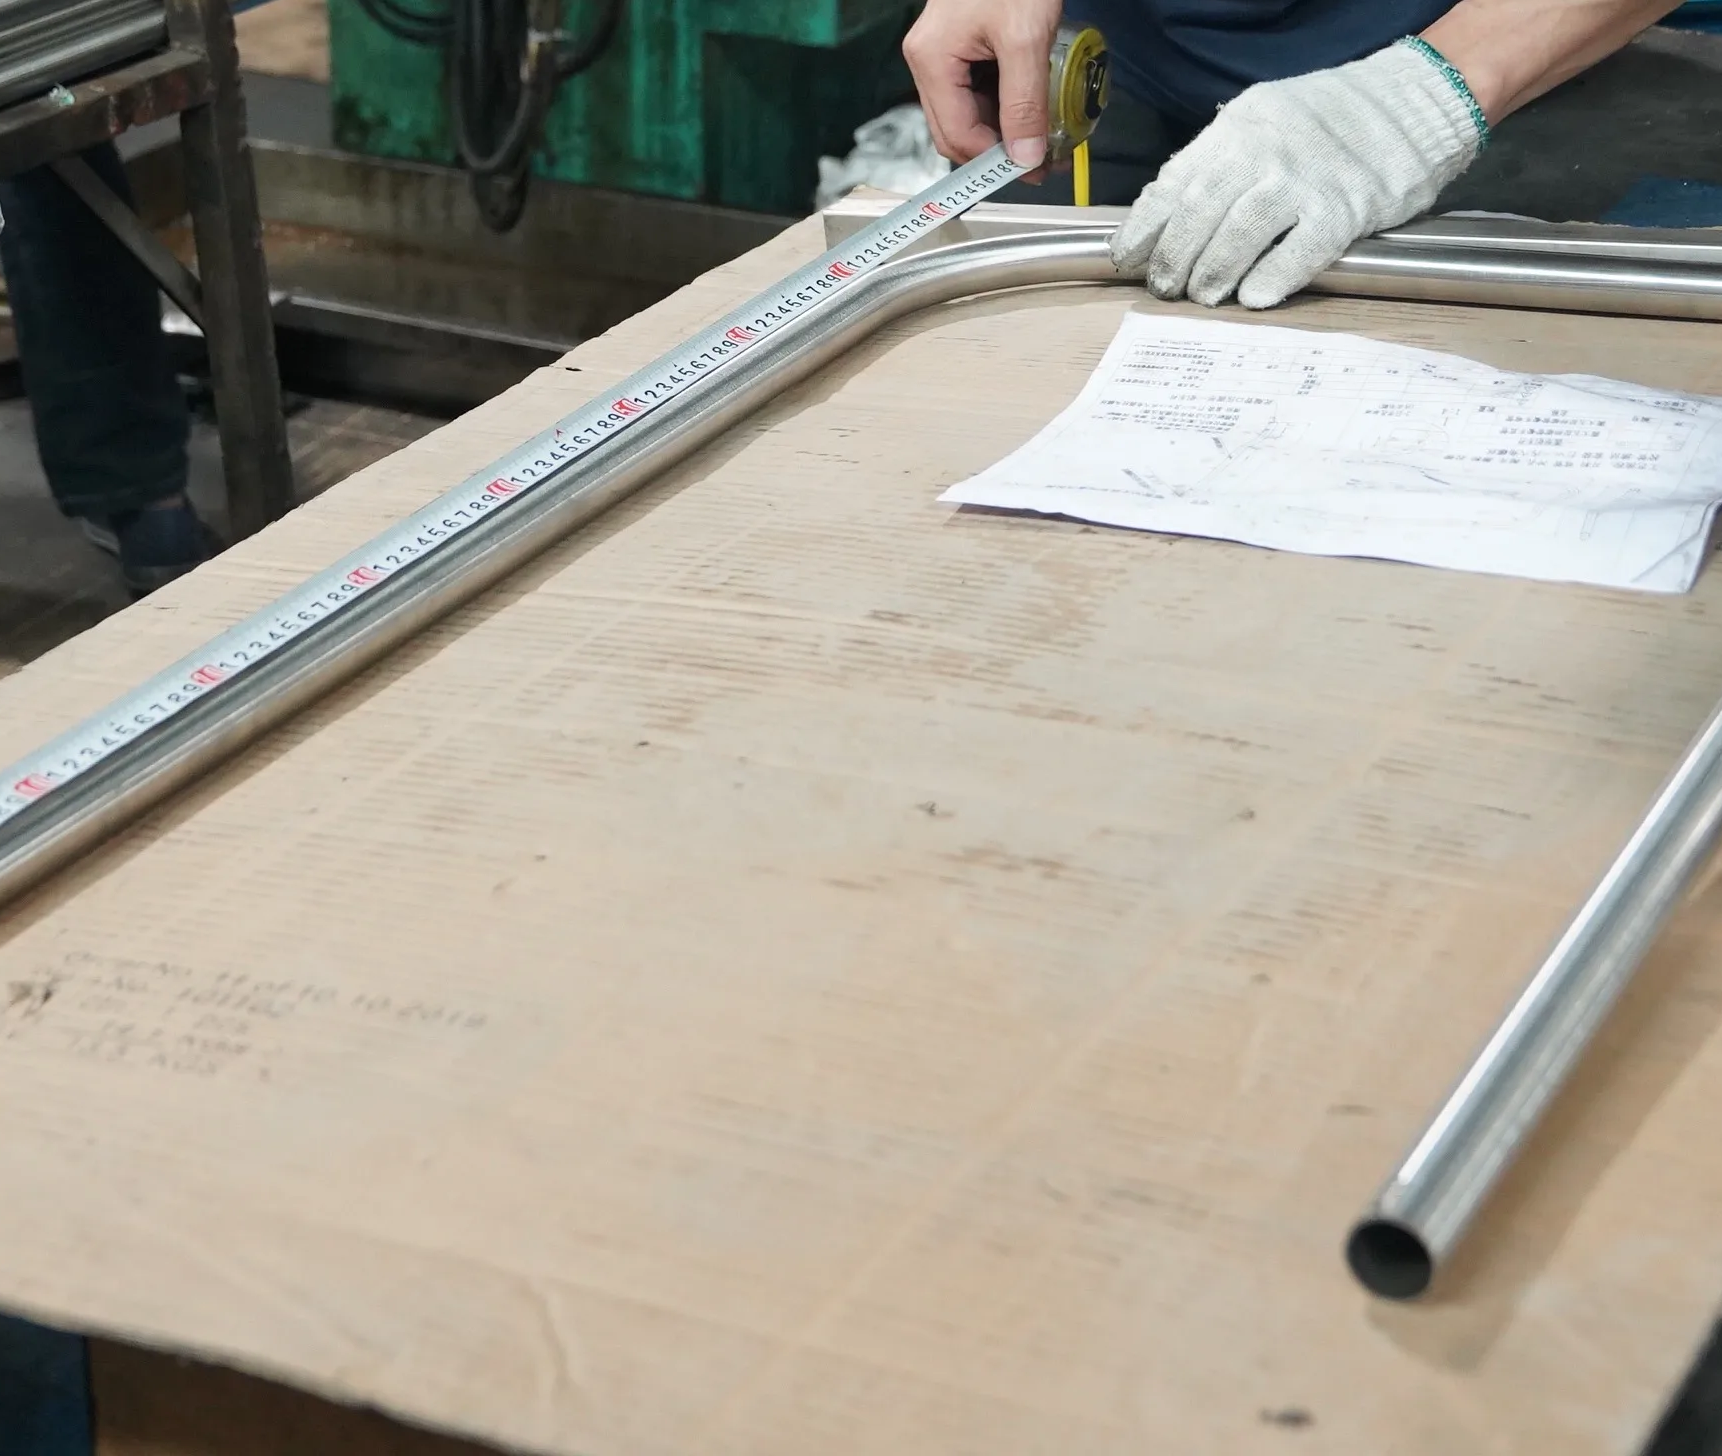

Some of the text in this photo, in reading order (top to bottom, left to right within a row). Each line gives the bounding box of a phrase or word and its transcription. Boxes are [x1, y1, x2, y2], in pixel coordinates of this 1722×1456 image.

[997, 163, 1012, 173] 8
[988, 169, 1003, 178] 7
[980, 174, 996, 184] 6
[971, 180, 987, 189] 5
[965, 185, 979, 194] 4
[954, 191, 970, 200] 3
[946, 196, 963, 206] 2
[938, 202, 953, 210] 1
[919, 213, 935, 222] 9
[911, 219, 927, 228] 8
[901, 224, 916, 233] 7
[892, 230, 909, 240] 6
[882, 236, 899, 246] 5
[875, 242, 890, 252] 4
[864, 248, 881, 258] 3
[855, 254, 873, 264] 2
[825, 274, 842, 283] 9
[816, 279, 833, 289] 8
[805, 285, 821, 295] 7
[796, 292, 813, 302] 6
[785, 298, 803, 308] 5
[777, 305, 793, 314] 4
[765, 312, 783, 322] 3
[755, 319, 773, 328] 2
[745, 325, 762, 333] 1
[721, 340, 739, 349] 9
[712, 346, 730, 356] 8
[699, 353, 717, 362] 7
[690, 360, 708, 370] 6
[677, 367, 697, 376] 5
[669, 375, 685, 384] 4
[655, 382, 674, 392] 3
[644, 390, 664, 399] 2
[607, 413, 626, 422] 9
[597, 420, 615, 429] 8
[583, 427, 601, 436] 7
[573, 435, 591, 444] 6
[559, 443, 579, 452] 5
[550, 451, 567, 461] 4
[534, 460, 554, 469] 3
[522, 468, 542, 477] 2
[481, 494, 500, 503] 9
[469, 501, 489, 510] 8
[454, 510, 472, 518] 7
[442, 519, 461, 528] 6
[427, 528, 447, 536] 5
[417, 537, 433, 546] 4
[386, 555, 403, 564] 2
